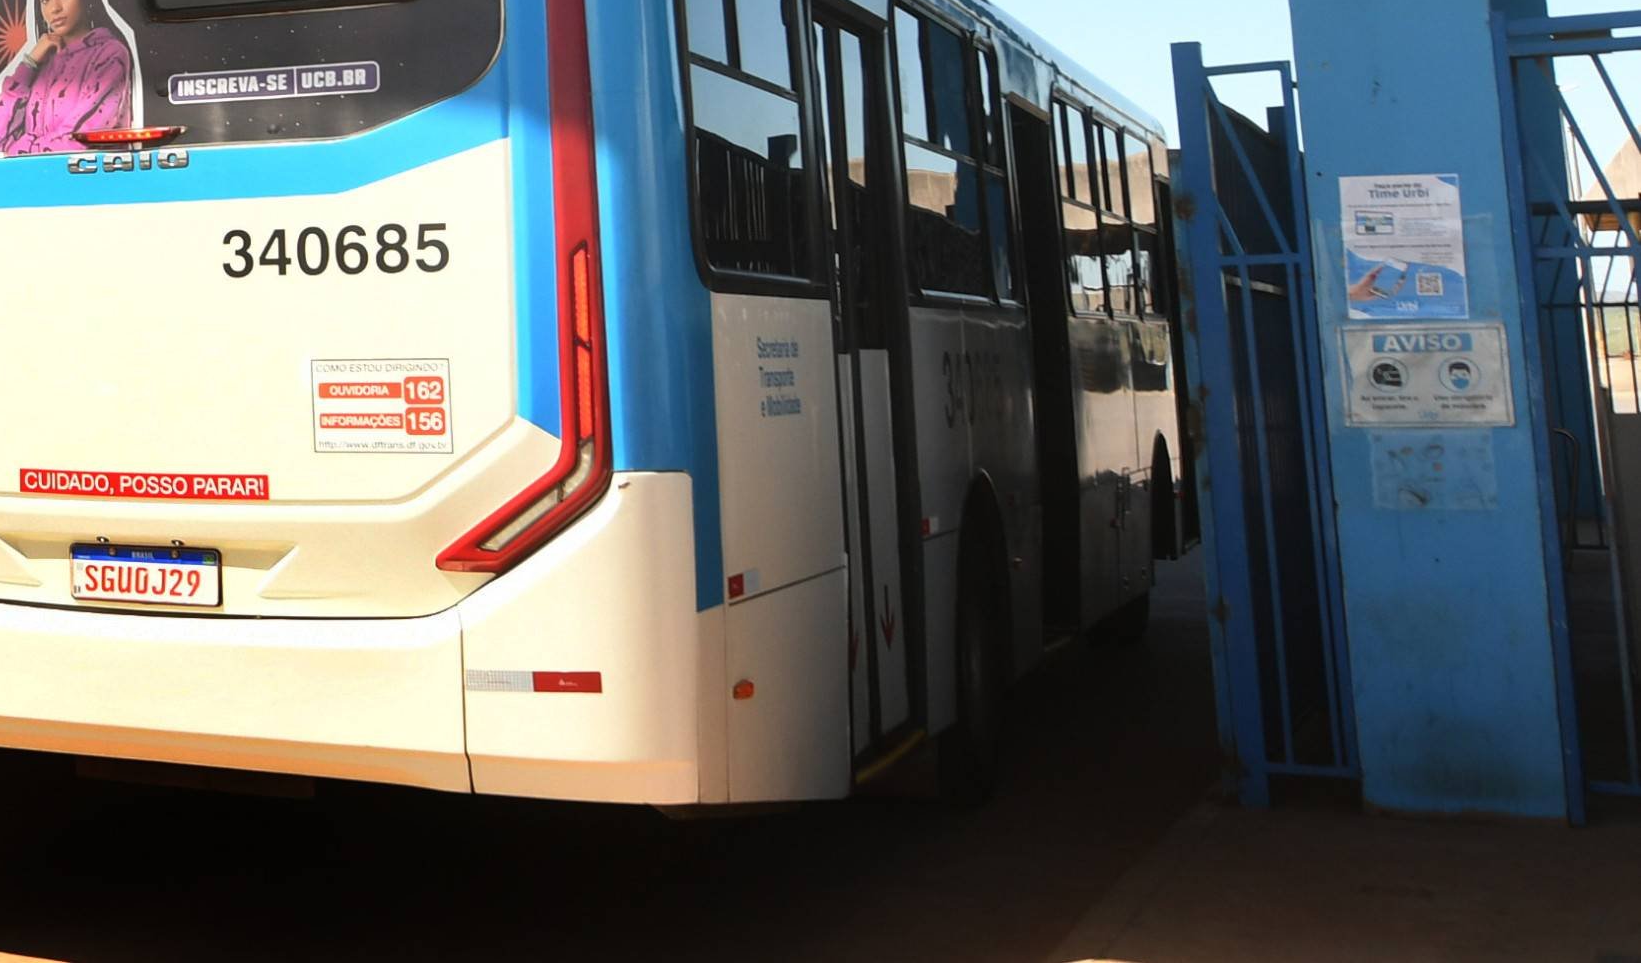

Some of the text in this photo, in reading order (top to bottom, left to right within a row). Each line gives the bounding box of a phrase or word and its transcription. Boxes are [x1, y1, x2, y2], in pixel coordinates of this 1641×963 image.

[177, 68, 367, 97] INSCREVA-SE UCB.BR
[1368, 188, 1430, 199] Time Urbi
[222, 222, 450, 278] 340685
[1383, 335, 1462, 352] AVISO
[329, 381, 442, 400] OUVIDORIA 162
[320, 412, 443, 431] INFORMAÇÕES 156
[24, 472, 265, 496] CUIDADO, POSSO PARAR!
